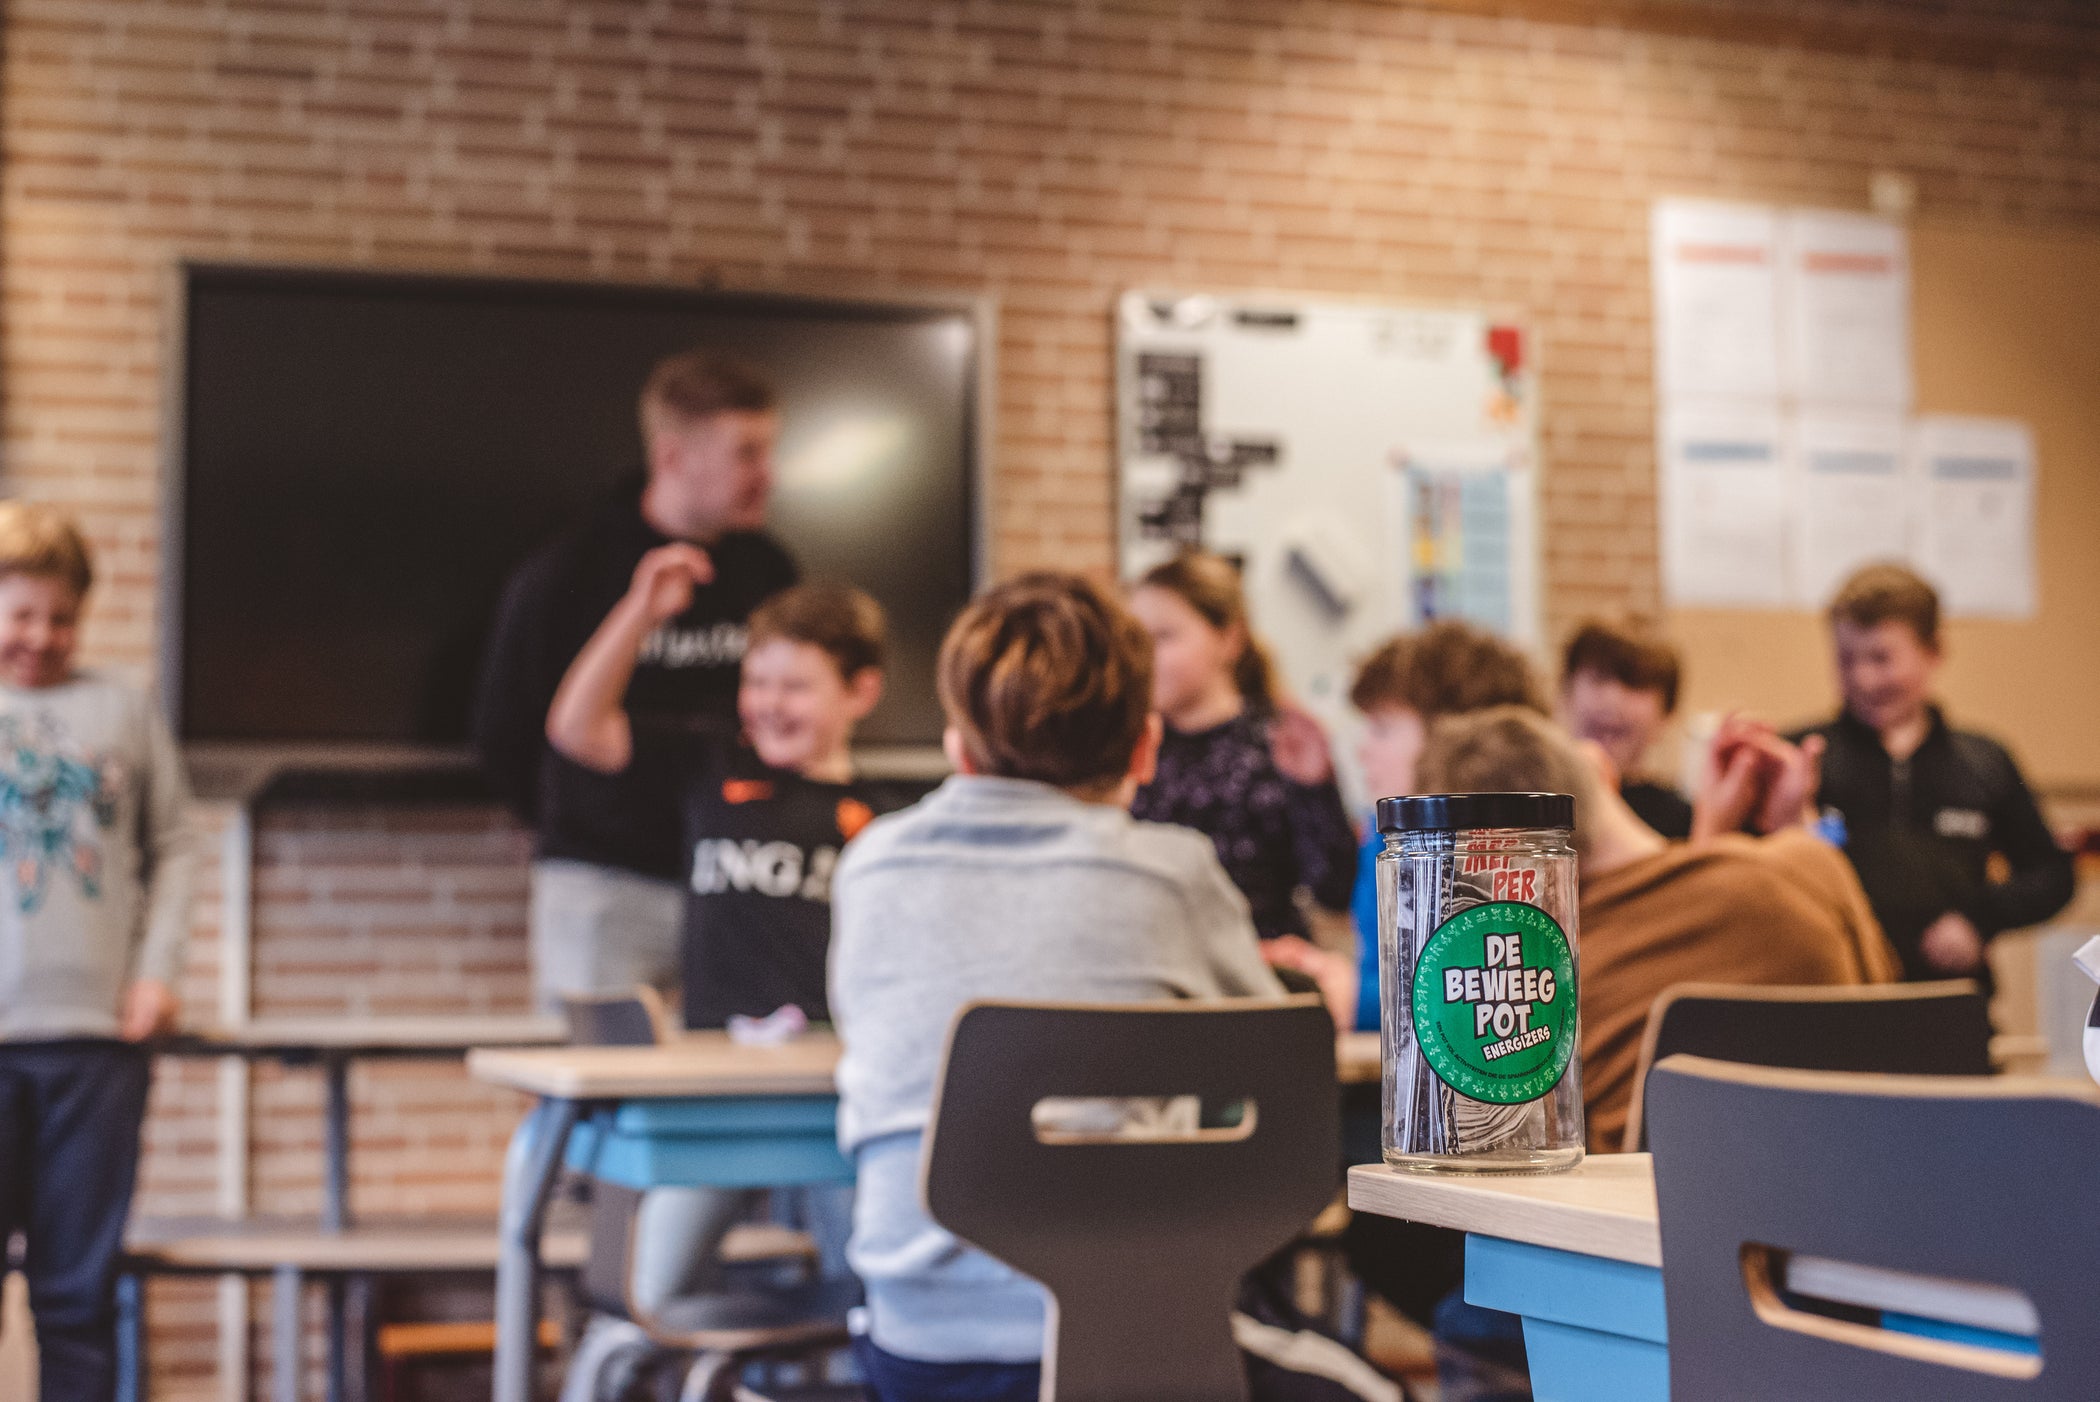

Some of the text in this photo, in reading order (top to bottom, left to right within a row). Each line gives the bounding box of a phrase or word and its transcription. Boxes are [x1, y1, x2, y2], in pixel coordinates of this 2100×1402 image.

[1493, 869, 1536, 901] PER
[1485, 933, 1522, 968] DE
[1444, 967, 1556, 1003] BEWEEG
[1475, 1002, 1532, 1038] POT
[1482, 1024, 1551, 1061] ENERGIZERS
